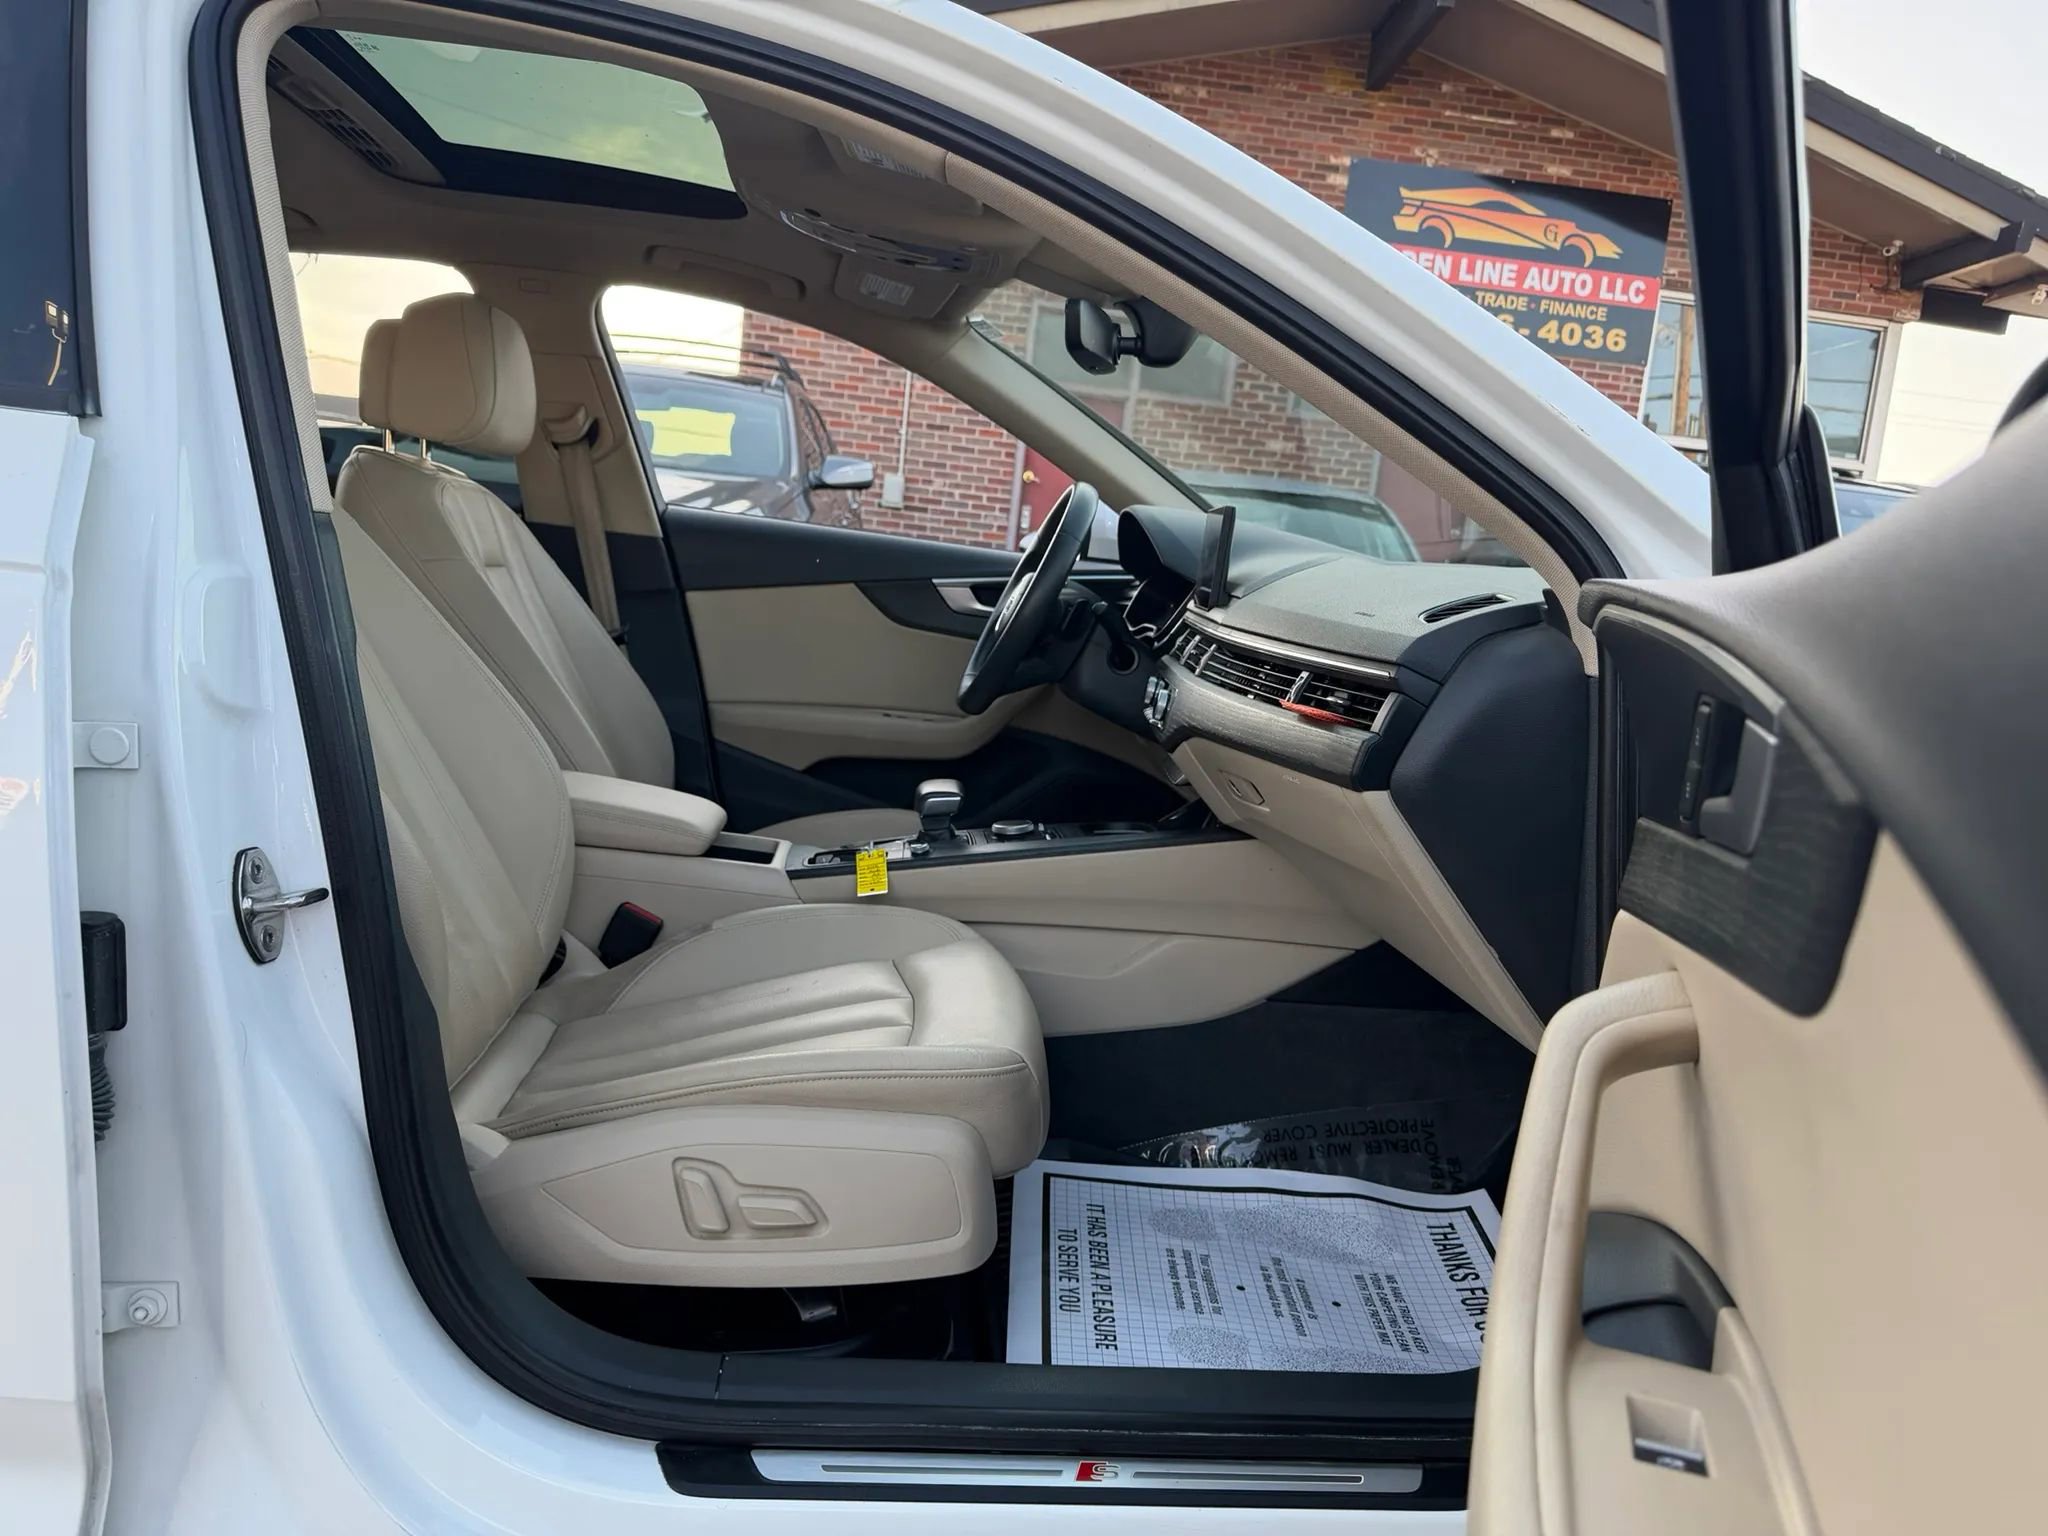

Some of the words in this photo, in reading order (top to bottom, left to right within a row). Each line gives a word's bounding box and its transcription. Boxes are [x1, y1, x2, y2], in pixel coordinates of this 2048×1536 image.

[1458, 256, 1519, 289] LINE
[1522, 265, 1594, 298] AUTO
[1599, 275, 1647, 305] LLC
[1475, 290, 1529, 312] TRADE
[1540, 298, 1608, 322] FINANCE
[1263, 1124, 1318, 1143] COVER
[1325, 1118, 1418, 1138] PROTECTIVE
[1364, 1138, 1422, 1155] DEALER
[1086, 1202, 1106, 1215] IT
[1057, 1228, 1078, 1243] TO
[1087, 1215, 1108, 1238] HAS
[1088, 1239, 1110, 1271] BEEN
[1426, 1222, 1481, 1283] THANKS
[1057, 1243, 1080, 1284] SERVE
[1090, 1271, 1111, 1281] A
[1368, 1272, 1384, 1292] YOUR
[1058, 1287, 1081, 1313] YOU
[1360, 1292, 1375, 1308] THIS
[1390, 1285, 1406, 1304] HAVE
[1091, 1282, 1118, 1351] PLEASURE
[1367, 1307, 1386, 1331] PAPER
[1375, 1290, 1402, 1329] CARPETING
[1399, 1303, 1415, 1326] TRIED
[1376, 1330, 1394, 1347] MAT
[1392, 1328, 1413, 1353] CLEAN
[1406, 1325, 1420, 1337] TO
[1412, 1336, 1429, 1354] KEEP
